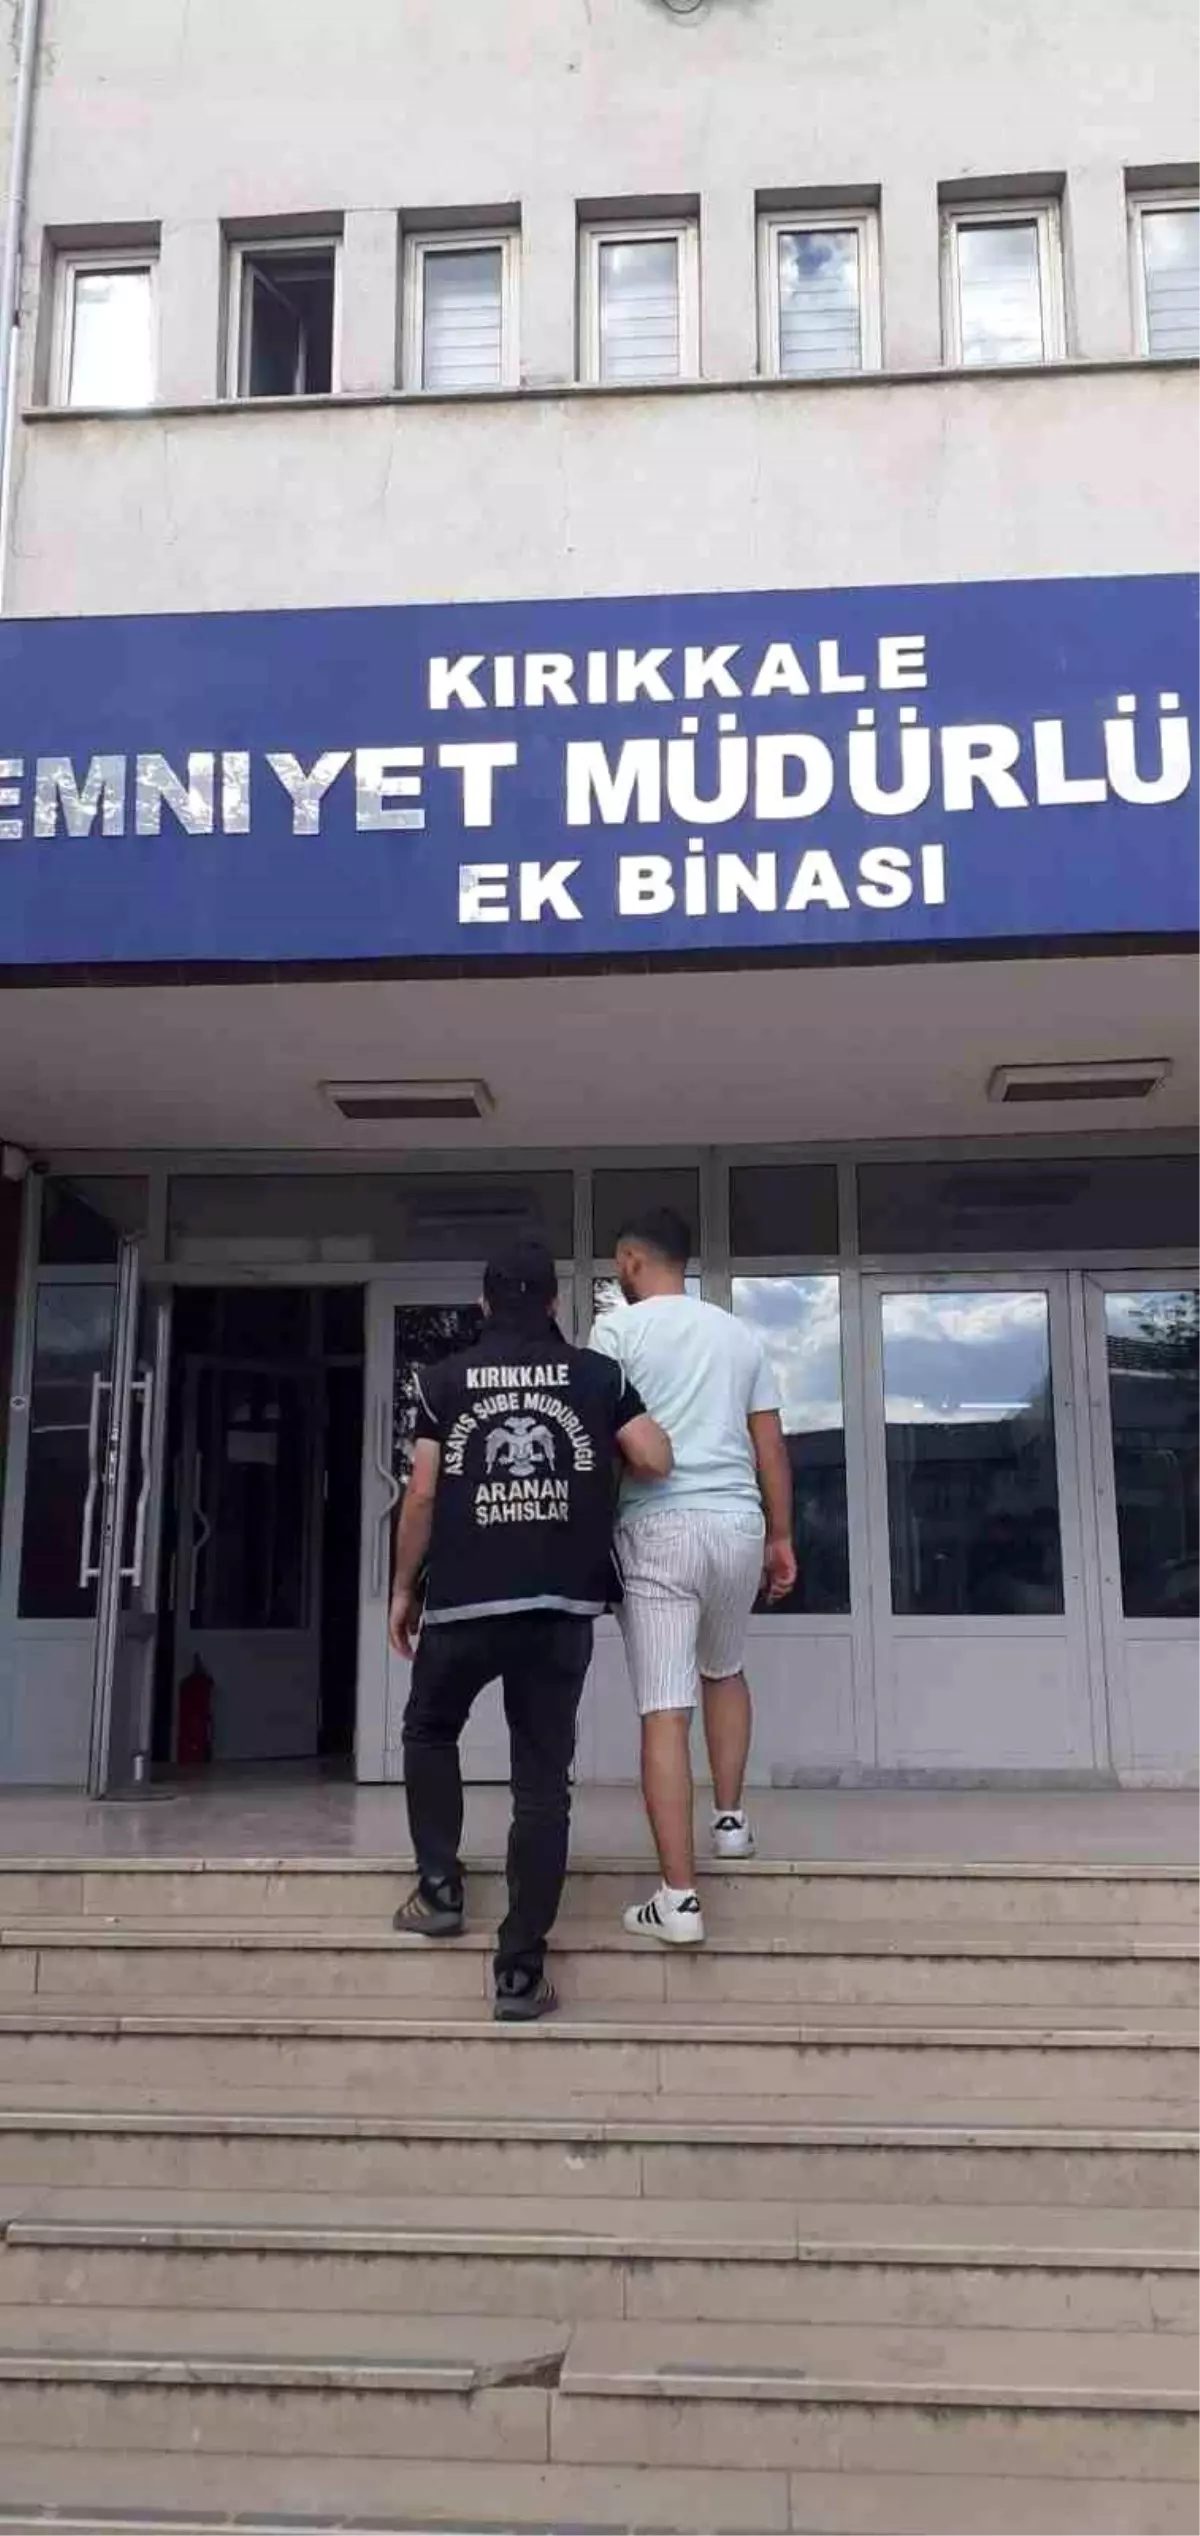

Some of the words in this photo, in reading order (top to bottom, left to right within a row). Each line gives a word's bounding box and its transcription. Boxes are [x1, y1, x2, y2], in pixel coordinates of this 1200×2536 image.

[429, 636, 928, 709] KIRIKKALE
[458, 860, 583, 923] EK
[618, 838, 946, 916] BİNASI
[465, 1364, 570, 1389] KIRIKKALE
[474, 1479, 569, 1504] ARANAN
